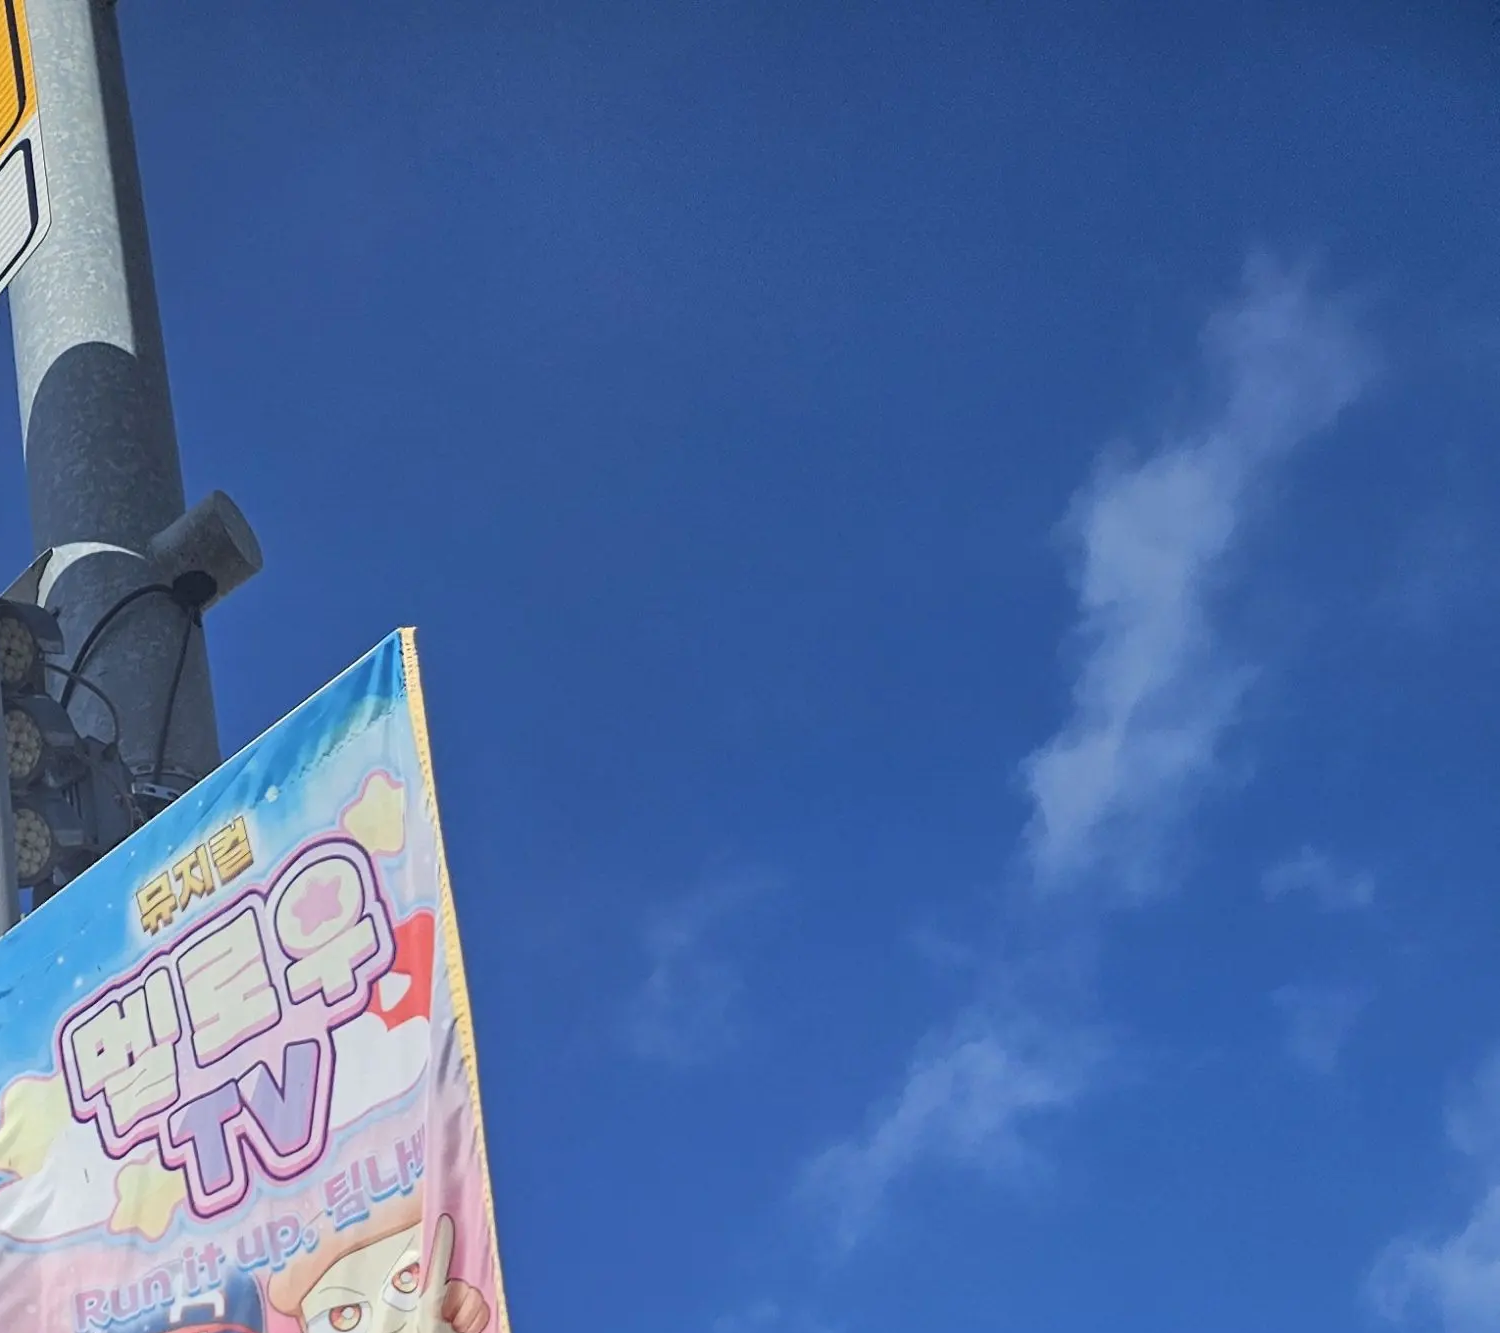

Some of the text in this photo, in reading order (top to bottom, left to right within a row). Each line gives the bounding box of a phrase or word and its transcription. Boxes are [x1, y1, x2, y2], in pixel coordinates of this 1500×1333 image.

[135, 815, 256, 936] 뮤지컬
[64, 840, 384, 1135] 멜로우
[166, 1036, 323, 1200] TV
[181, 1241, 225, 1297] it
[236, 1213, 320, 1272] up,
